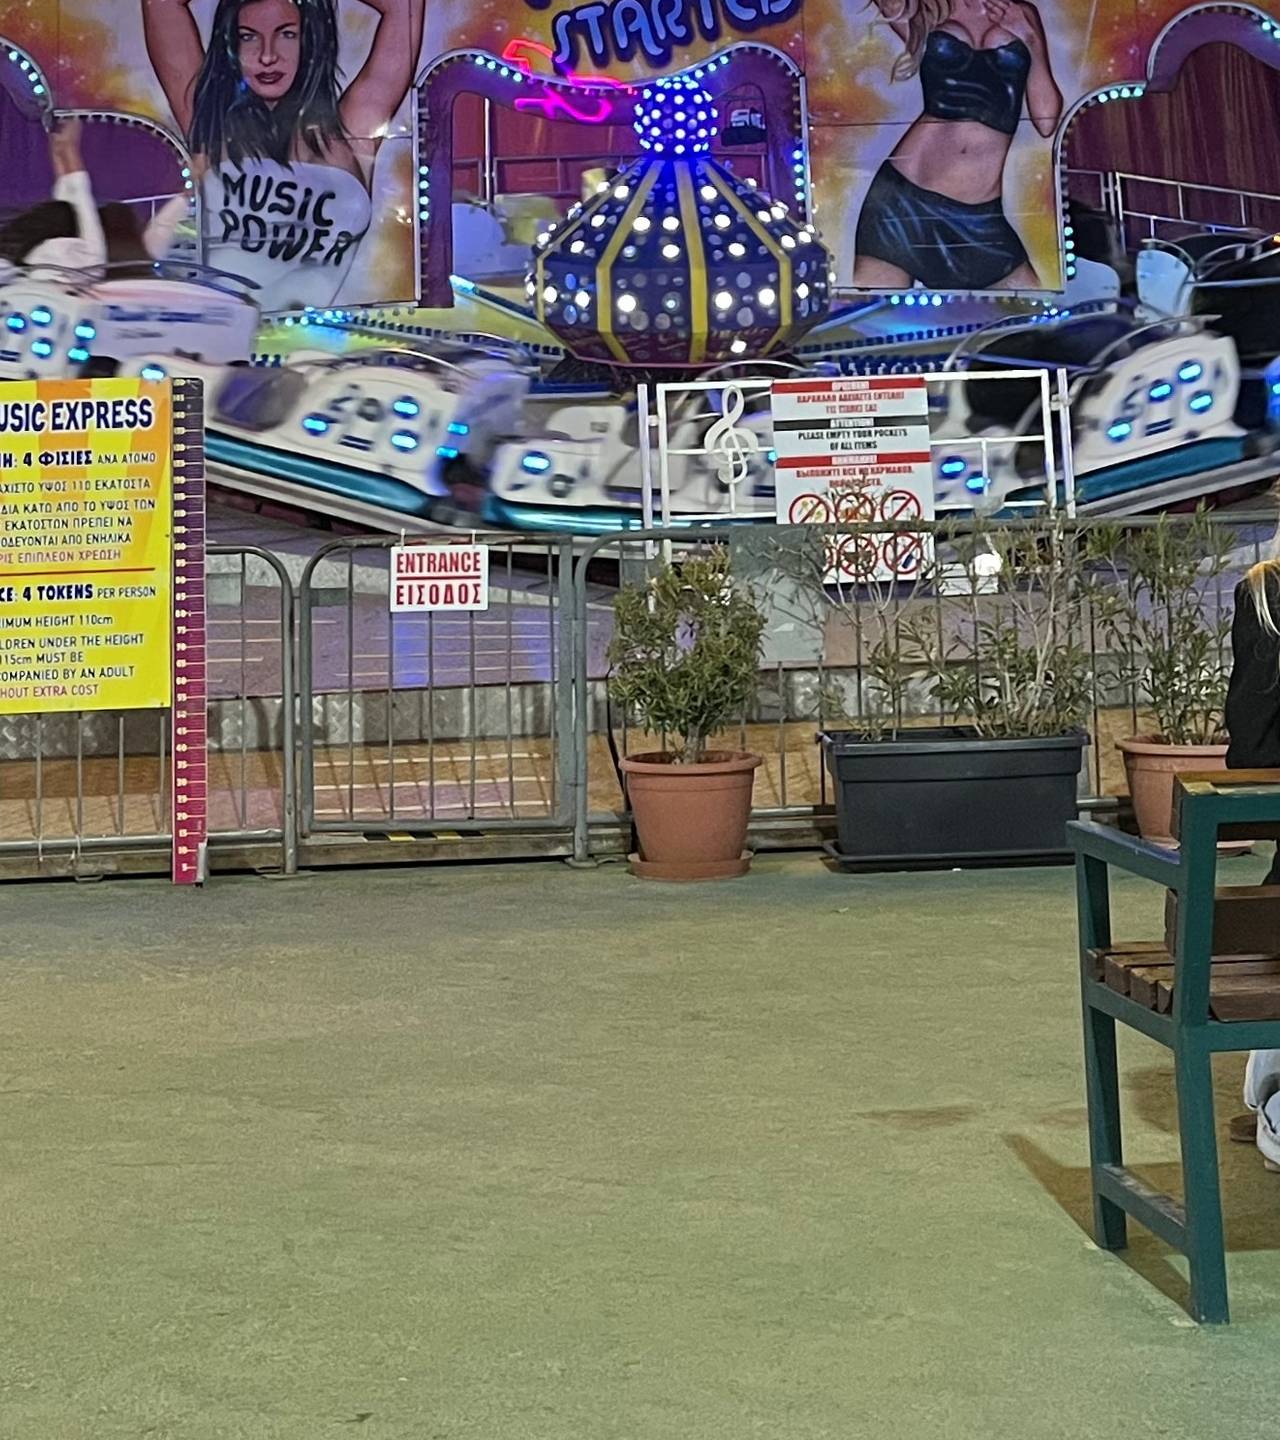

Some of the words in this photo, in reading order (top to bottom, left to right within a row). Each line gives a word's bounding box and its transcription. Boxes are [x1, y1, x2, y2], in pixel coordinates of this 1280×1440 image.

[222, 173, 336, 227] MUSIC
[219, 209, 352, 266] POWER
[51, 399, 153, 430] EXPRESS
[798, 432, 824, 440] PLEASE
[826, 431, 851, 439] EMPTY
[853, 430, 872, 438] YOUR
[874, 429, 907, 437] POCKETS
[841, 442, 852, 450] ALL
[855, 441, 877, 449] ITEMS
[23, 453, 33, 466] 4
[38, 451, 92, 466] ΦΙΣΙΕΣ
[98, 454, 118, 464] ΑΝΑ
[121, 453, 156, 462] ΑΤΟΜΟ
[39, 481, 67, 492] ΥΨΟΣ
[73, 480, 91, 491] 110
[95, 478, 150, 490] ΕΚΑΤΟΣΤΑ
[23, 503, 52, 513] ΚΑΤΩ
[56, 502, 78, 512] ΑΠΟ
[83, 501, 96, 511] ΤΟ
[100, 500, 129, 510] ΥΨΟΣ
[134, 499, 155, 509] ΤΩΝ
[4, 519, 69, 531] ΕΚΑΤΟΣΤΩΝ
[73, 517, 113, 528] ΠΡΕΠΕΙ
[118, 517, 132, 527] ΝΑ
[62, 535, 83, 545] ΑΠΟ
[86, 533, 131, 544] ΕΝΗΛΙΚΑ
[18, 551, 74, 563] ΕΠΙΠΛΕΟΝ
[78, 549, 121, 560] ΧΡΕΩΣΗ
[396, 550, 482, 574] ENTRANCE
[23, 586, 32, 601] 4
[37, 584, 93, 600] TOKENS
[97, 588, 115, 598] PER
[118, 586, 156, 597] PERSON
[395, 581, 482, 606] ΕΙΣΟΔΟΣ
[35, 616, 75, 627] HEIGHT
[79, 615, 113, 625] 110cm
[39, 637, 77, 648] UNDER
[81, 636, 101, 646] THE
[105, 634, 144, 645] HEIGHT
[36, 652, 66, 663] MUST
[70, 652, 83, 662] BE
[63, 668, 76, 679] BY
[80, 668, 95, 678] AN
[99, 666, 134, 677] ADULT
[33, 685, 68, 697] EXTRA
[71, 684, 98, 695] COST
